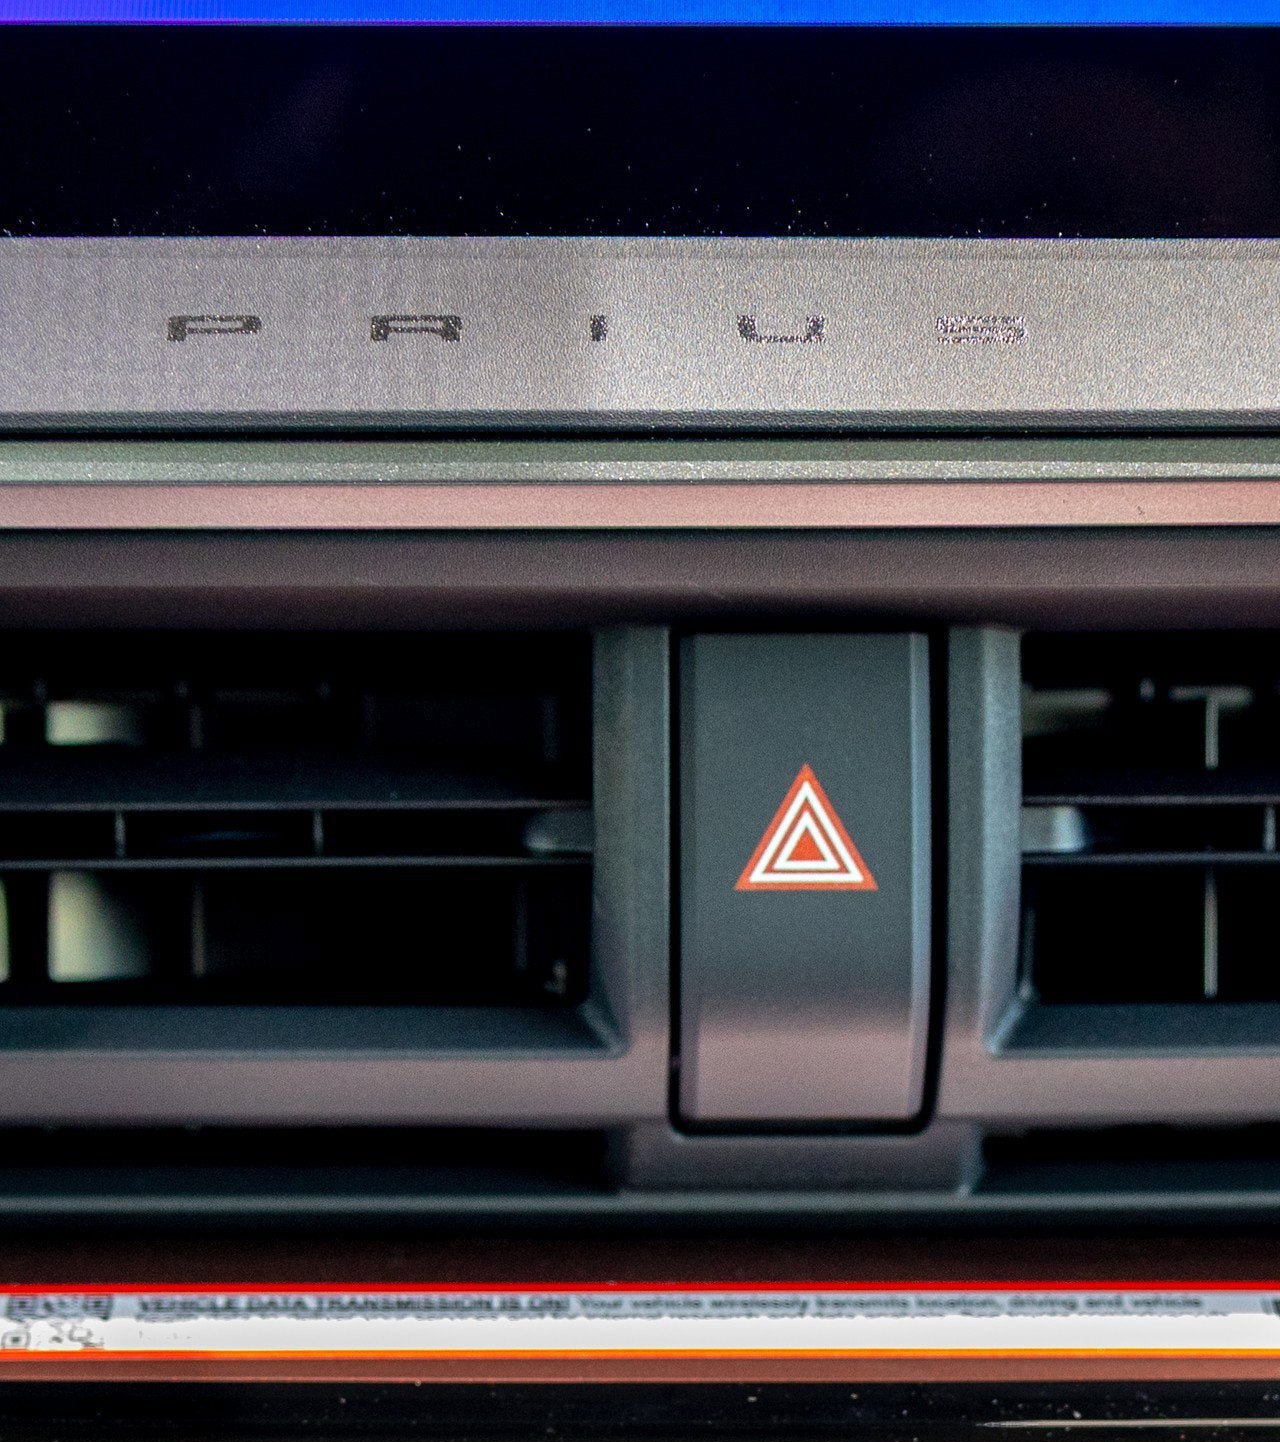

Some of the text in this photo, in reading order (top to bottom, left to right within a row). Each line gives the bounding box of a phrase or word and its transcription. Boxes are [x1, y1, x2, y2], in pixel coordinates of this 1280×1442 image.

[166, 314, 1028, 344] PRIUS
[138, 1296, 238, 1312] VEHICLE
[246, 1296, 310, 1312] DATA
[313, 1296, 492, 1312] TRANSMISSION
